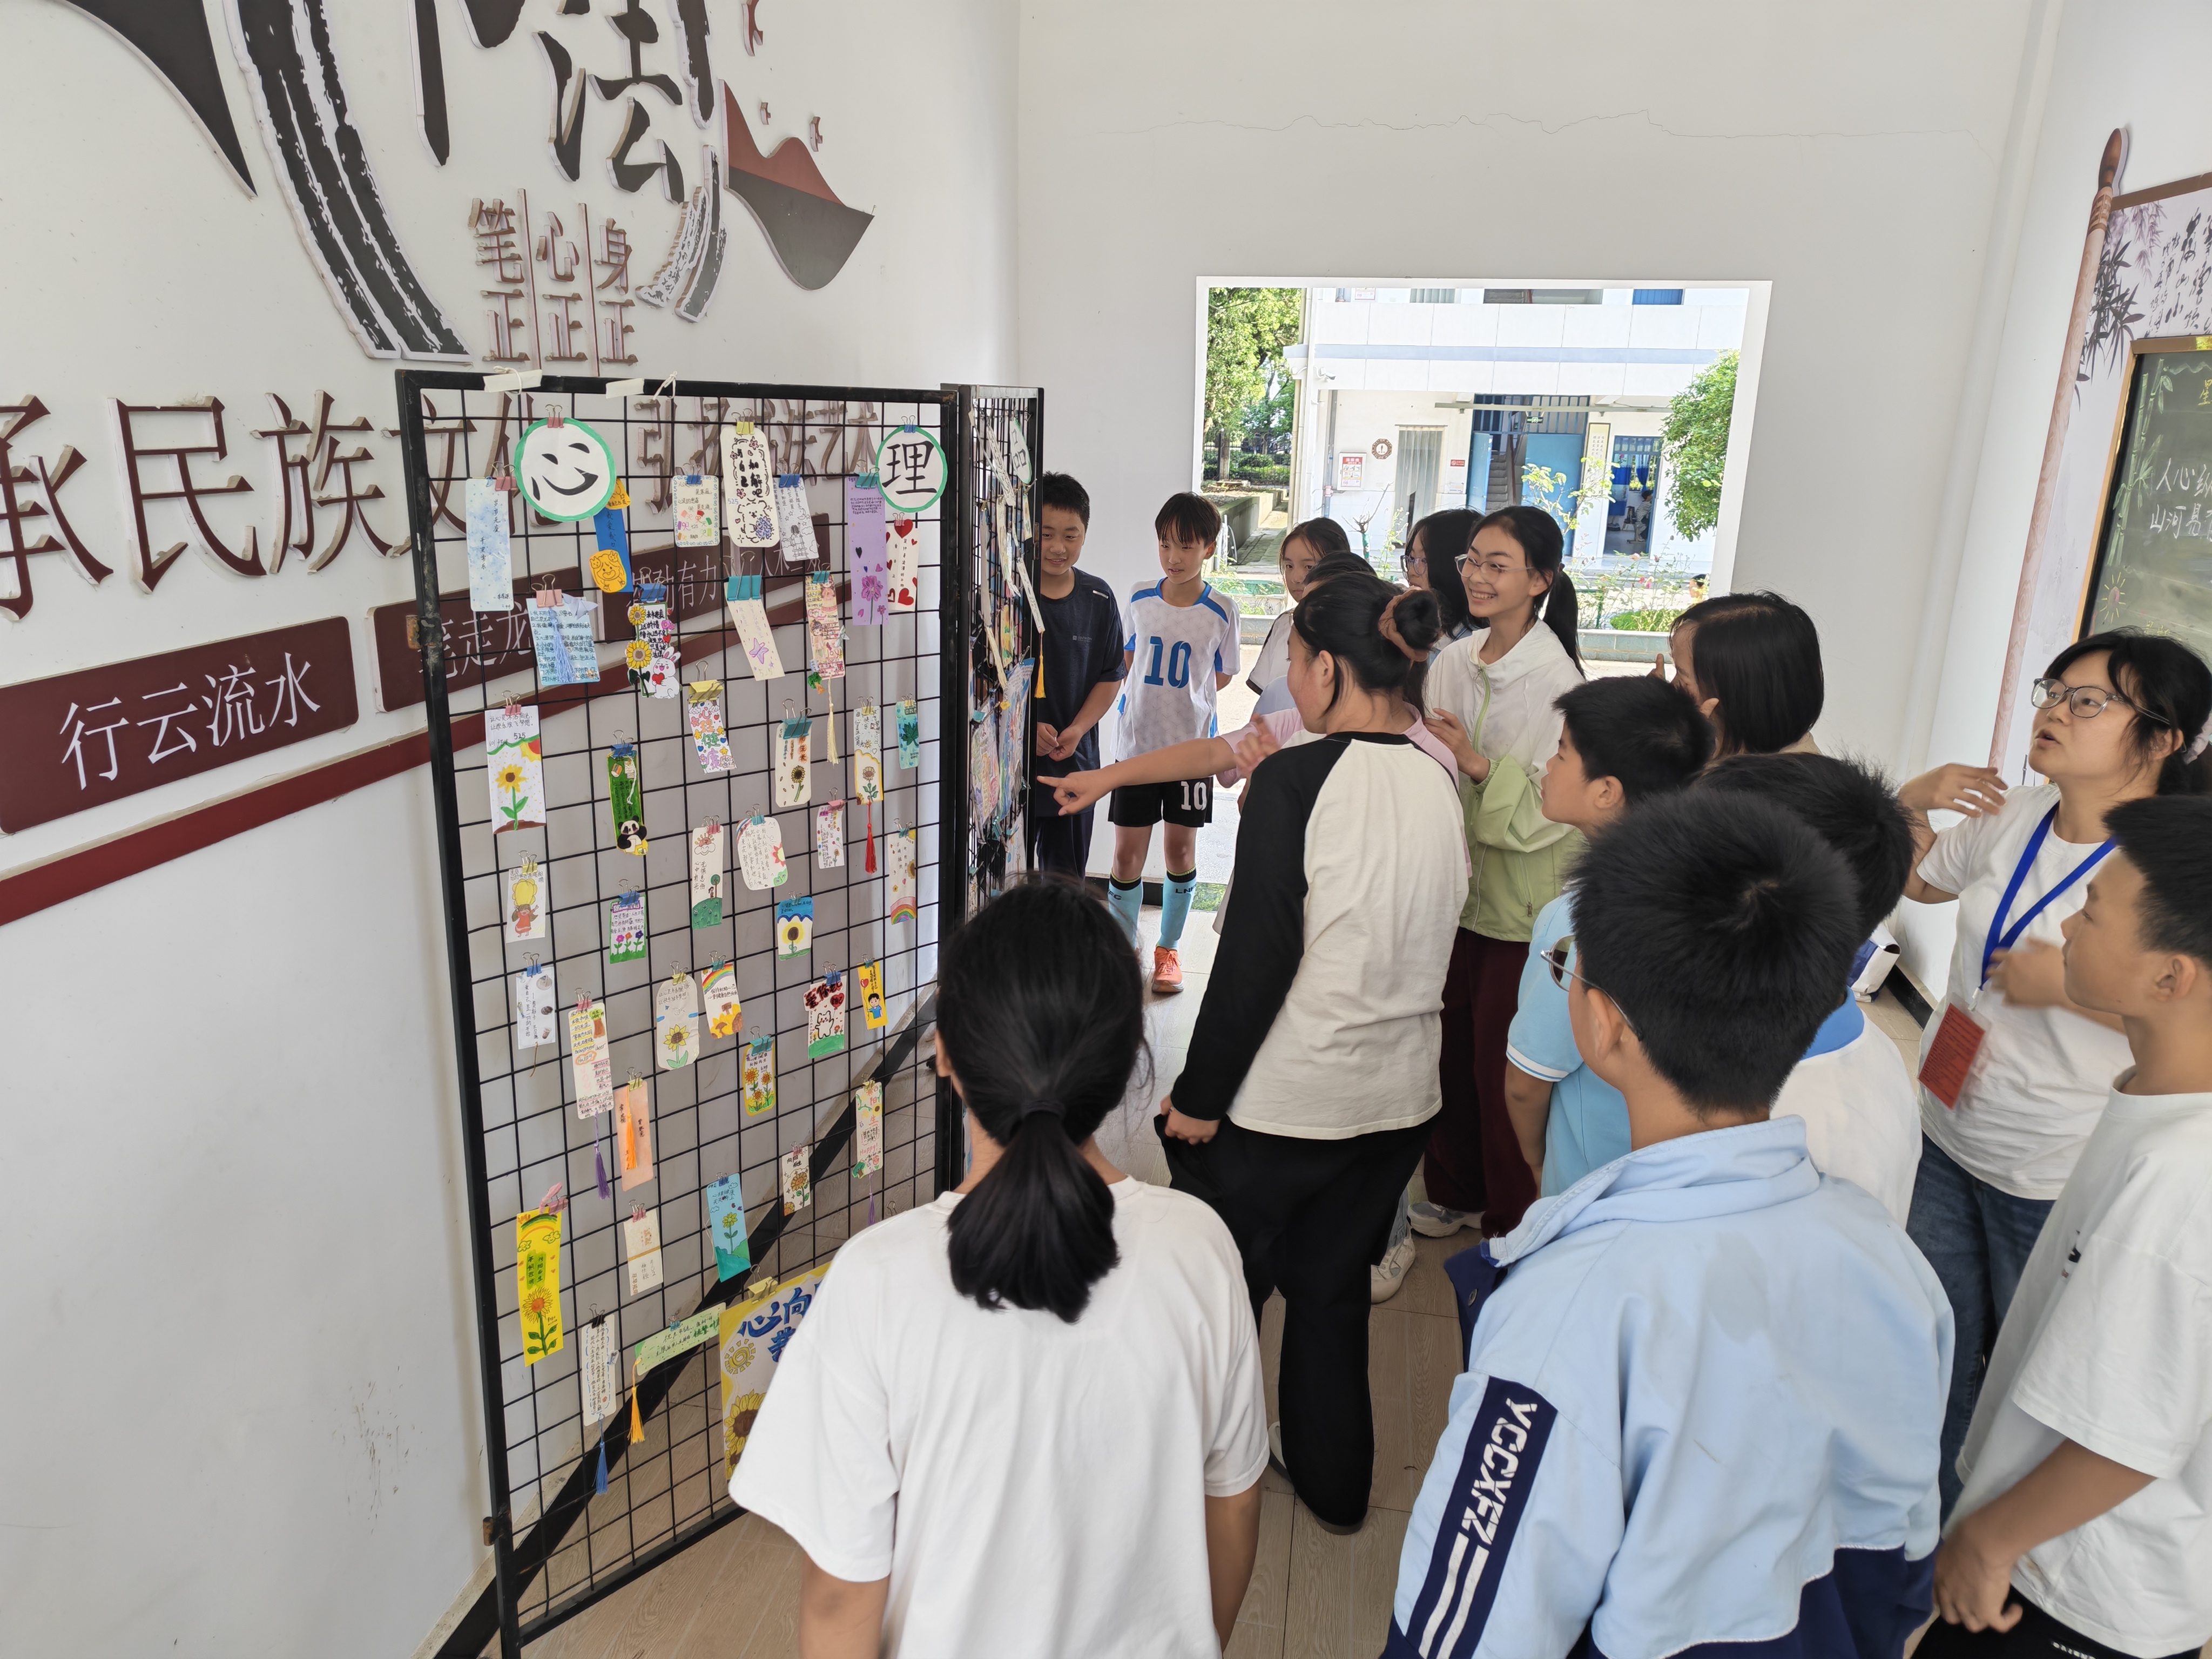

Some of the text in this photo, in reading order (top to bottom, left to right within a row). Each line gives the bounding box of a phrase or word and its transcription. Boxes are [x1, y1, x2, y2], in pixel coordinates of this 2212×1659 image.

[536, 211, 588, 361] 心正
[595, 218, 638, 365] 身正
[531, 442, 598, 501] 心
[882, 440, 937, 495] 理
[1144, 636, 1192, 689] 10
[60, 652, 321, 791] 行云流水
[698, 707, 721, 770] 心理健康
[1181, 781, 1207, 810] 10
[1463, 1398, 1537, 1545] YCCXFZ
